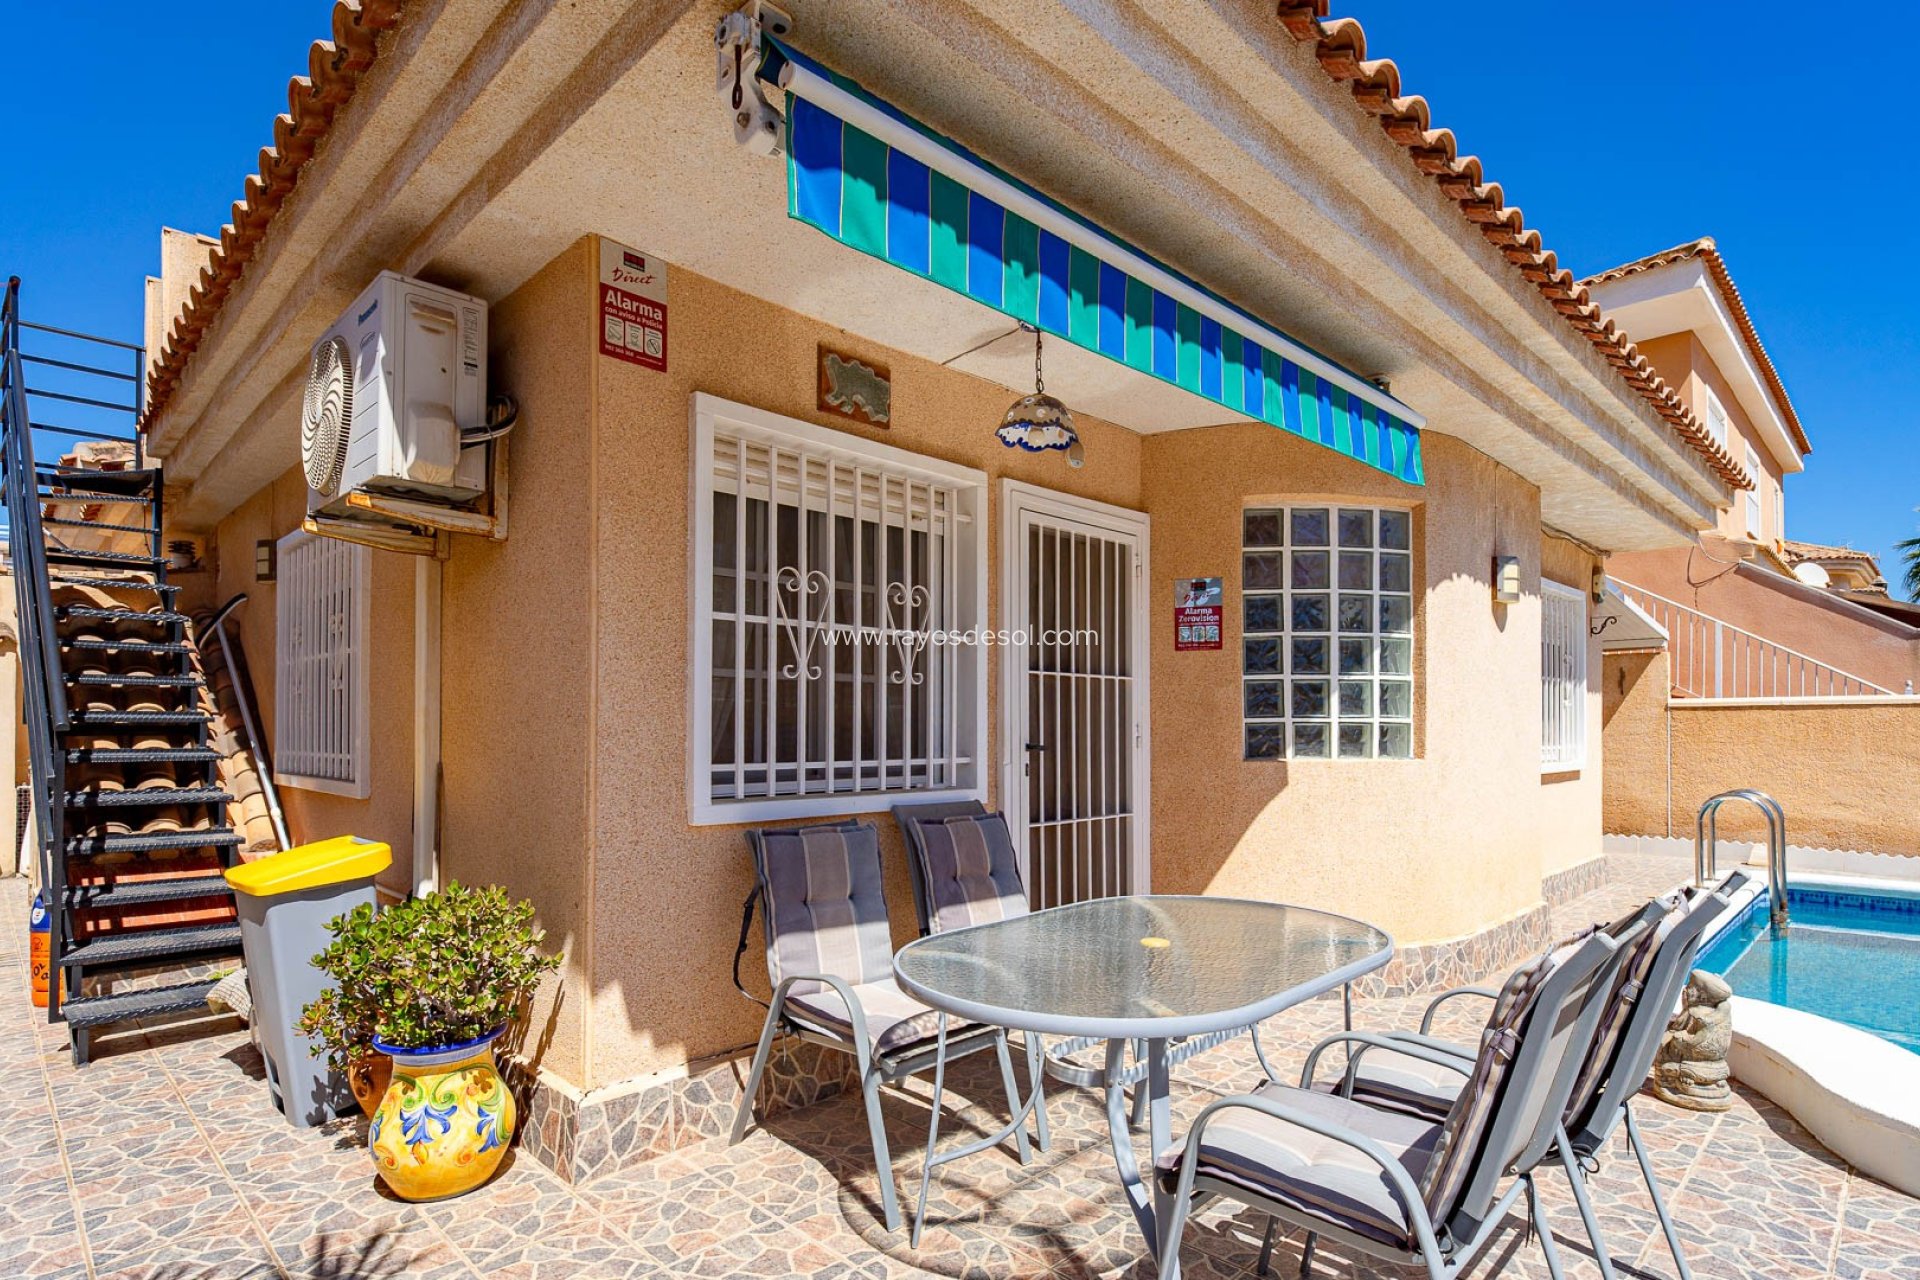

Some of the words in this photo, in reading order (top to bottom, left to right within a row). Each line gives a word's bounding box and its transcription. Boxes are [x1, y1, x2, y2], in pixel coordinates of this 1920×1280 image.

[612, 266, 657, 285] Direct
[605, 289, 663, 320] Alarma
[1184, 607, 1213, 615] Alarma
